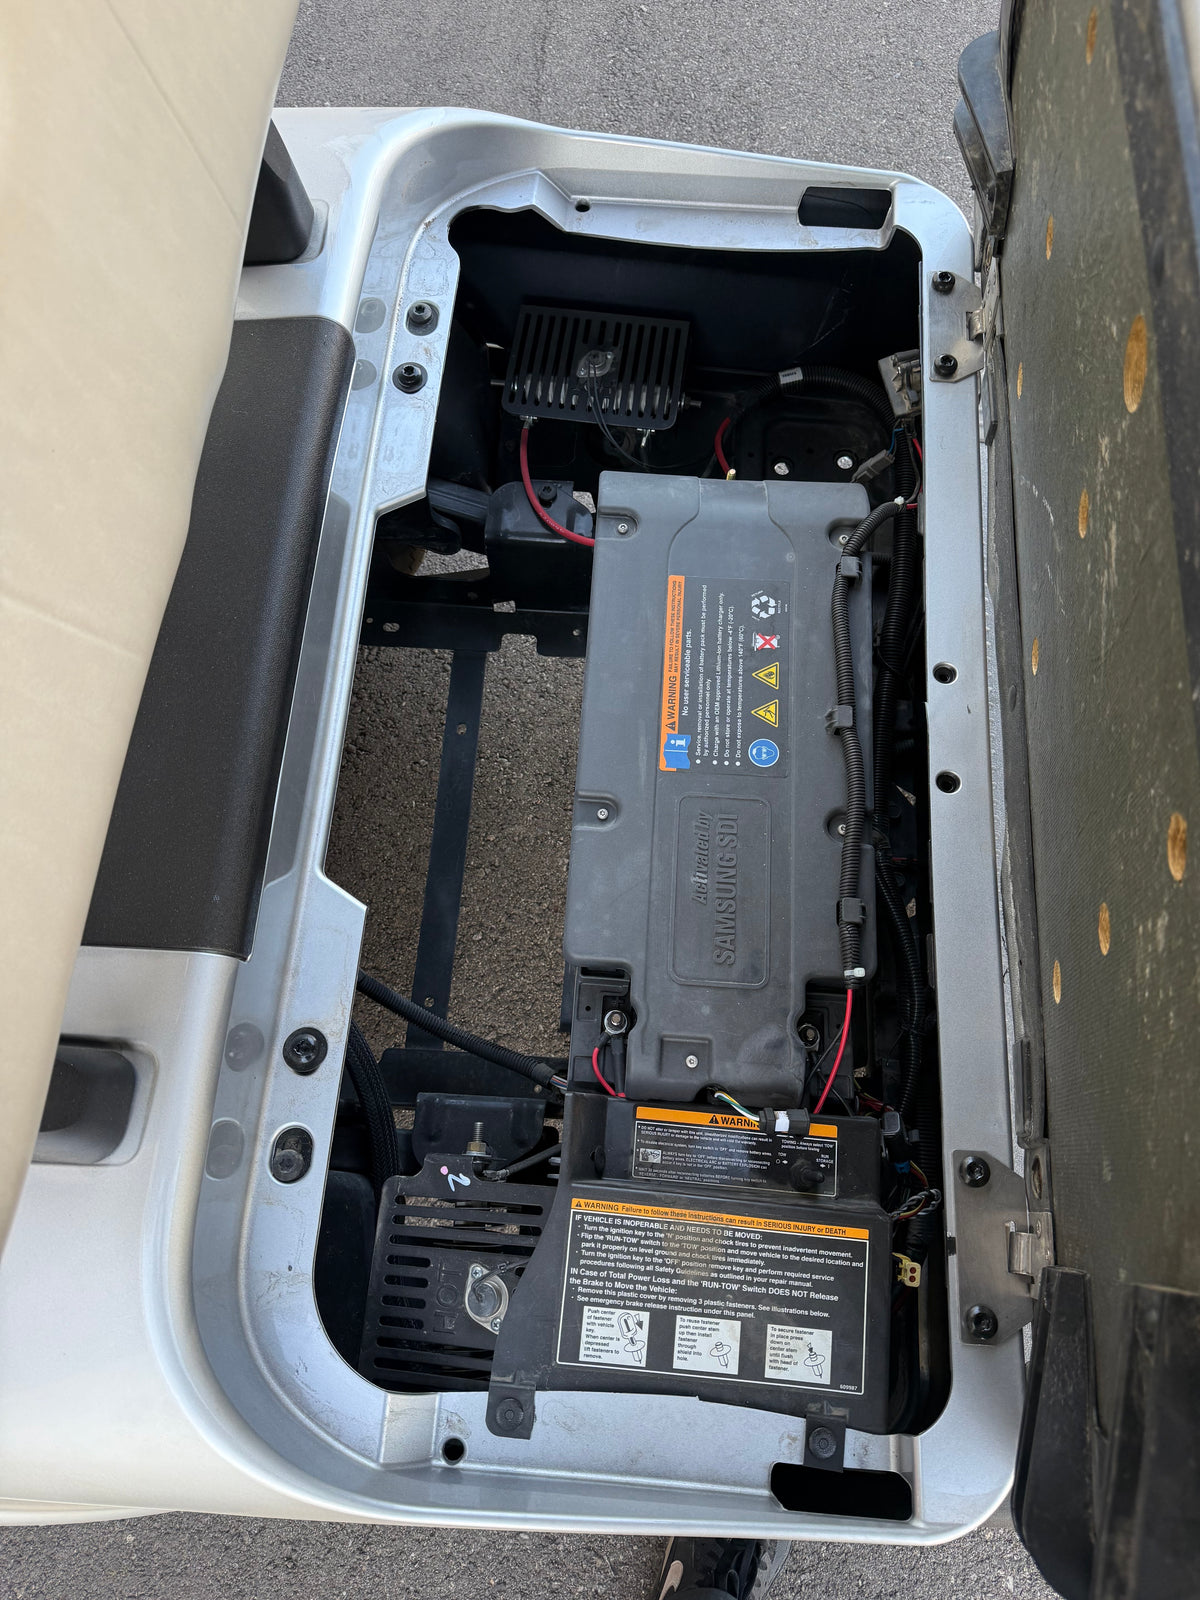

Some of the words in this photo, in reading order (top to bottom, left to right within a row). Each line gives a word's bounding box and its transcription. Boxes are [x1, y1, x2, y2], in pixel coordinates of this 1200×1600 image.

[685, 628, 693, 648] parts.
[682, 649, 691, 687] serviceable
[666, 675, 677, 719] WARNING
[681, 705, 688, 715] No
[702, 748, 709, 756] by
[712, 736, 720, 756] Charge
[723, 749, 729, 757] Do
[735, 749, 741, 757] Do
[716, 813, 738, 849] SDI
[692, 831, 709, 905] Activated
[713, 852, 737, 966] SAMSUNG
[583, 1201, 618, 1211] WARNING
[621, 1205, 642, 1213] Failure
[650, 1208, 669, 1216] follow
[669, 1210, 687, 1218] these
[687, 1211, 724, 1222] instructions
[763, 1220, 791, 1229] SERIOUS
[792, 1223, 815, 1232] INJURY
[824, 1227, 846, 1235] DEATH
[583, 1214, 613, 1224] VEHICLE
[622, 1218, 668, 1230] INOPERABLE
[669, 1223, 685, 1231] AND
[686, 1225, 710, 1234] NEEDS
[723, 1229, 733, 1237] BE
[734, 1231, 762, 1240] MOVED:
[581, 1240, 595, 1249] park
[601, 1243, 628, 1252] properly
[654, 1249, 677, 1257] ground
[726, 1255, 765, 1266] immediately.
[569, 1276, 581, 1284] the
[582, 1277, 604, 1287] Brake
[614, 1281, 634, 1289] Move
[635, 1283, 647, 1291] the
[648, 1284, 677, 1294] Vehicle:
[579, 1267, 598, 1276] Case
[599, 1269, 607, 1277] of
[608, 1270, 626, 1279] Total
[627, 1272, 650, 1282] Power
[652, 1275, 670, 1284] Loss
[671, 1277, 685, 1285] and
[741, 1284, 766, 1293] Switch
[768, 1286, 790, 1296] DOES
[791, 1289, 808, 1298] NOT
[809, 1291, 838, 1301] Release
[433, 1262, 461, 1335] HOT
[576, 1294, 589, 1302] See
[589, 1296, 624, 1306] emergency
[625, 1299, 643, 1307] brake
[644, 1301, 667, 1309] release
[668, 1303, 702, 1313] instruction
[703, 1307, 722, 1315] under
[736, 1310, 755, 1319] panel.
[577, 1286, 603, 1294] Remove
[617, 1290, 638, 1299] plastic
[658, 1294, 666, 1302] by
[667, 1295, 697, 1305] removing
[703, 1298, 724, 1308] plastic
[725, 1300, 756, 1310] fasteners.
[771, 1305, 808, 1315] illustrations
[809, 1309, 829, 1317] below.
